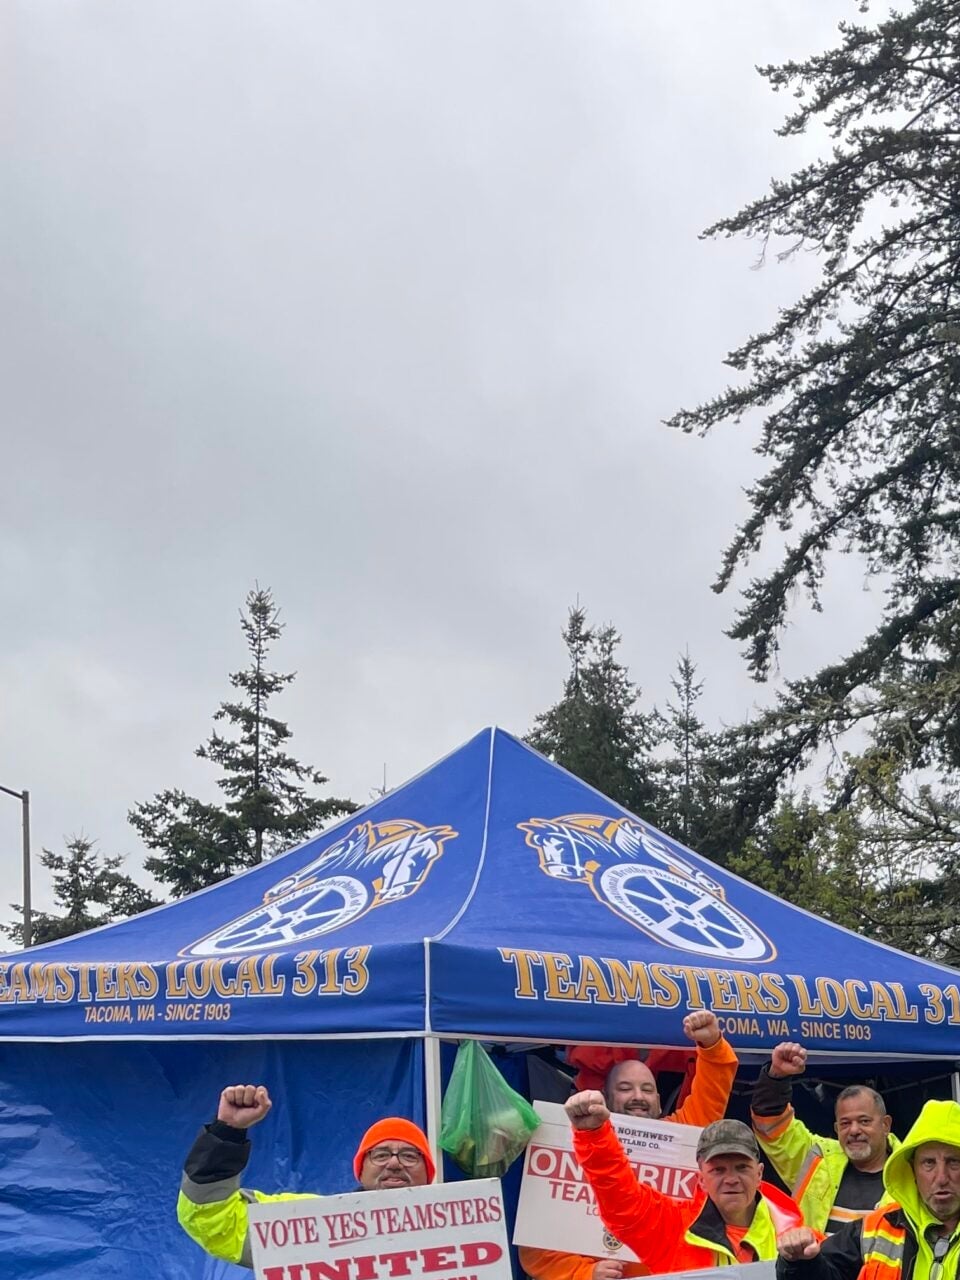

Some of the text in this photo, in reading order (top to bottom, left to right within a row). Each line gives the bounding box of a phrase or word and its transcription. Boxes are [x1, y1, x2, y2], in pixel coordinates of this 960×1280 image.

[0, 945, 372, 1004] EAMSTERS LOCAL 313
[497, 947, 790, 1015] TEAMSTERS
[786, 974, 918, 1024] LOCAL
[84, 1005, 133, 1024] TACOMA,
[137, 1004, 155, 1022] WA
[164, 1003, 201, 1021] SINCE
[204, 1003, 231, 1020] 1903
[718, 1017, 764, 1038] COMA,
[767, 1019, 790, 1036] WA
[801, 1022, 841, 1039] SINCE
[844, 1024, 872, 1041] 1903
[618, 1127, 675, 1143] NORTHWEST
[530, 1148, 582, 1181] ON
[254, 1196, 502, 1249] VOTE YES TEAMSTERS
